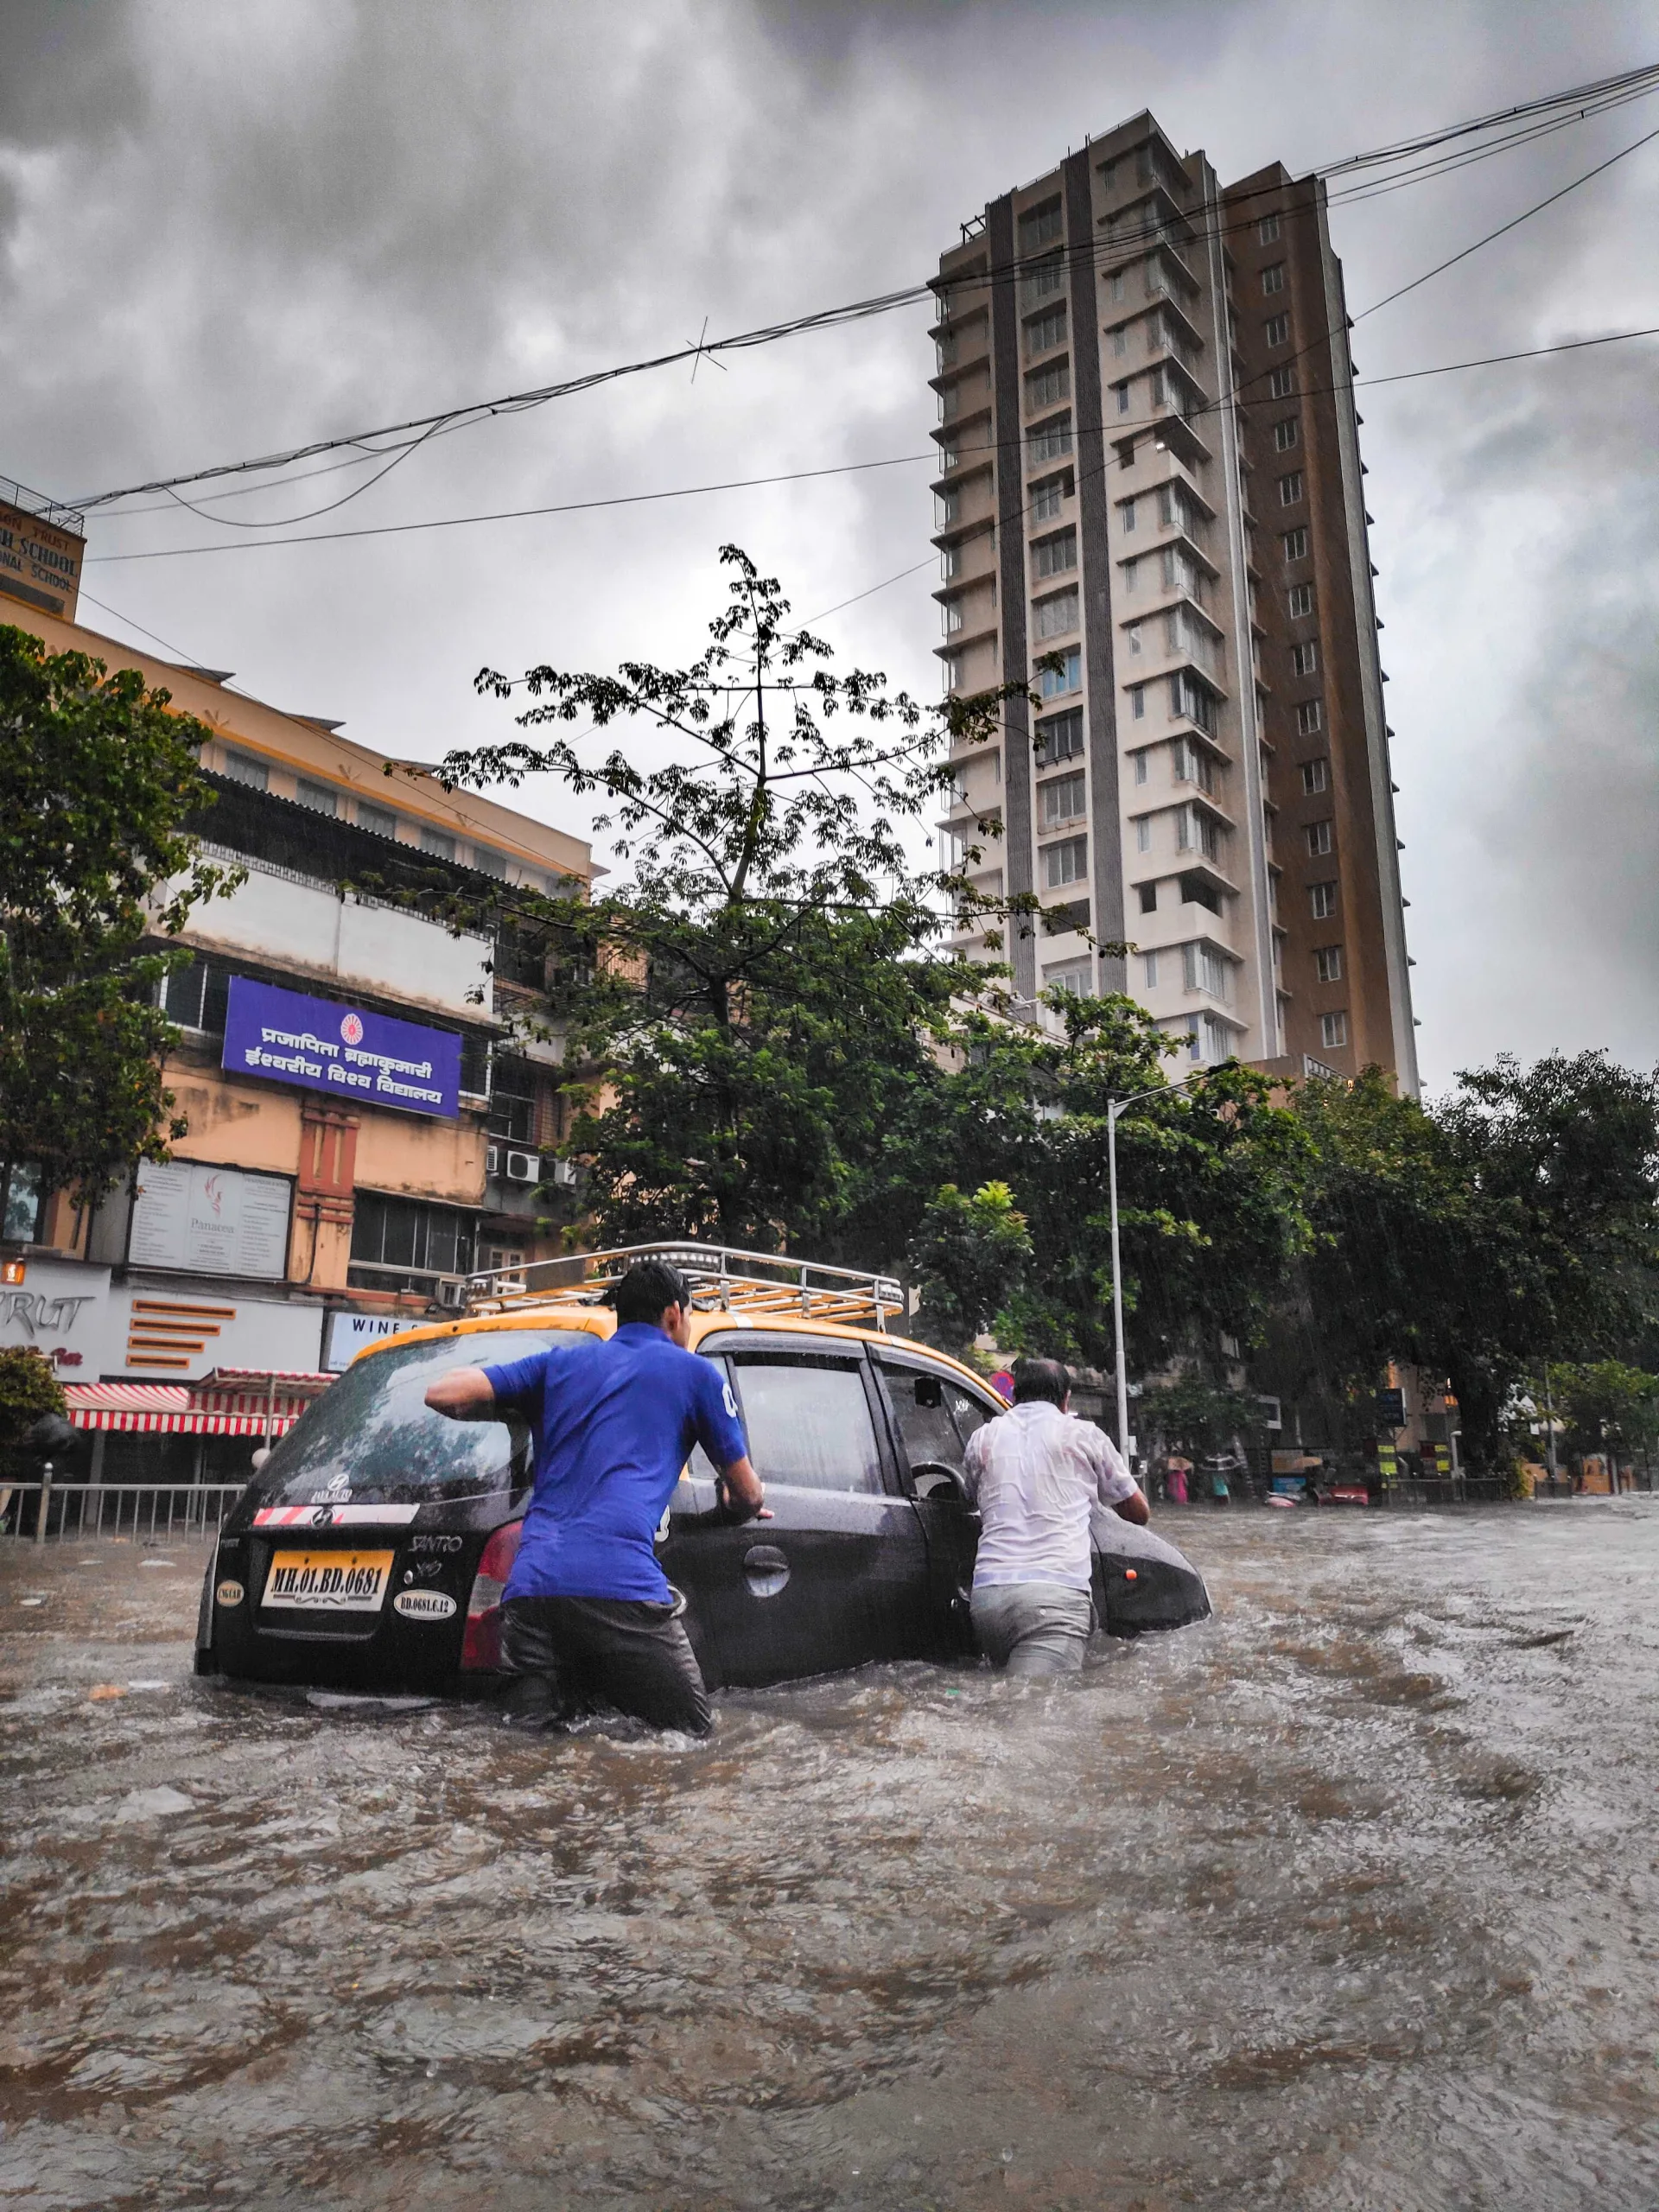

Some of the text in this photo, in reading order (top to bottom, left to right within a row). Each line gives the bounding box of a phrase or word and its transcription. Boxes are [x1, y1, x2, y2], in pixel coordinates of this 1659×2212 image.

[33, 526, 70, 552] TRUST
[261, 1027, 433, 1079] प्रजापिता ब्रह्माकुमारी
[245, 1046, 442, 1104] ईश्वरीय विश्व विद्यालय
[190, 1217, 234, 1234] Panacea
[353, 1319, 400, 1335] WINE
[270, 1567, 383, 1595] MH.01.BD.0681
